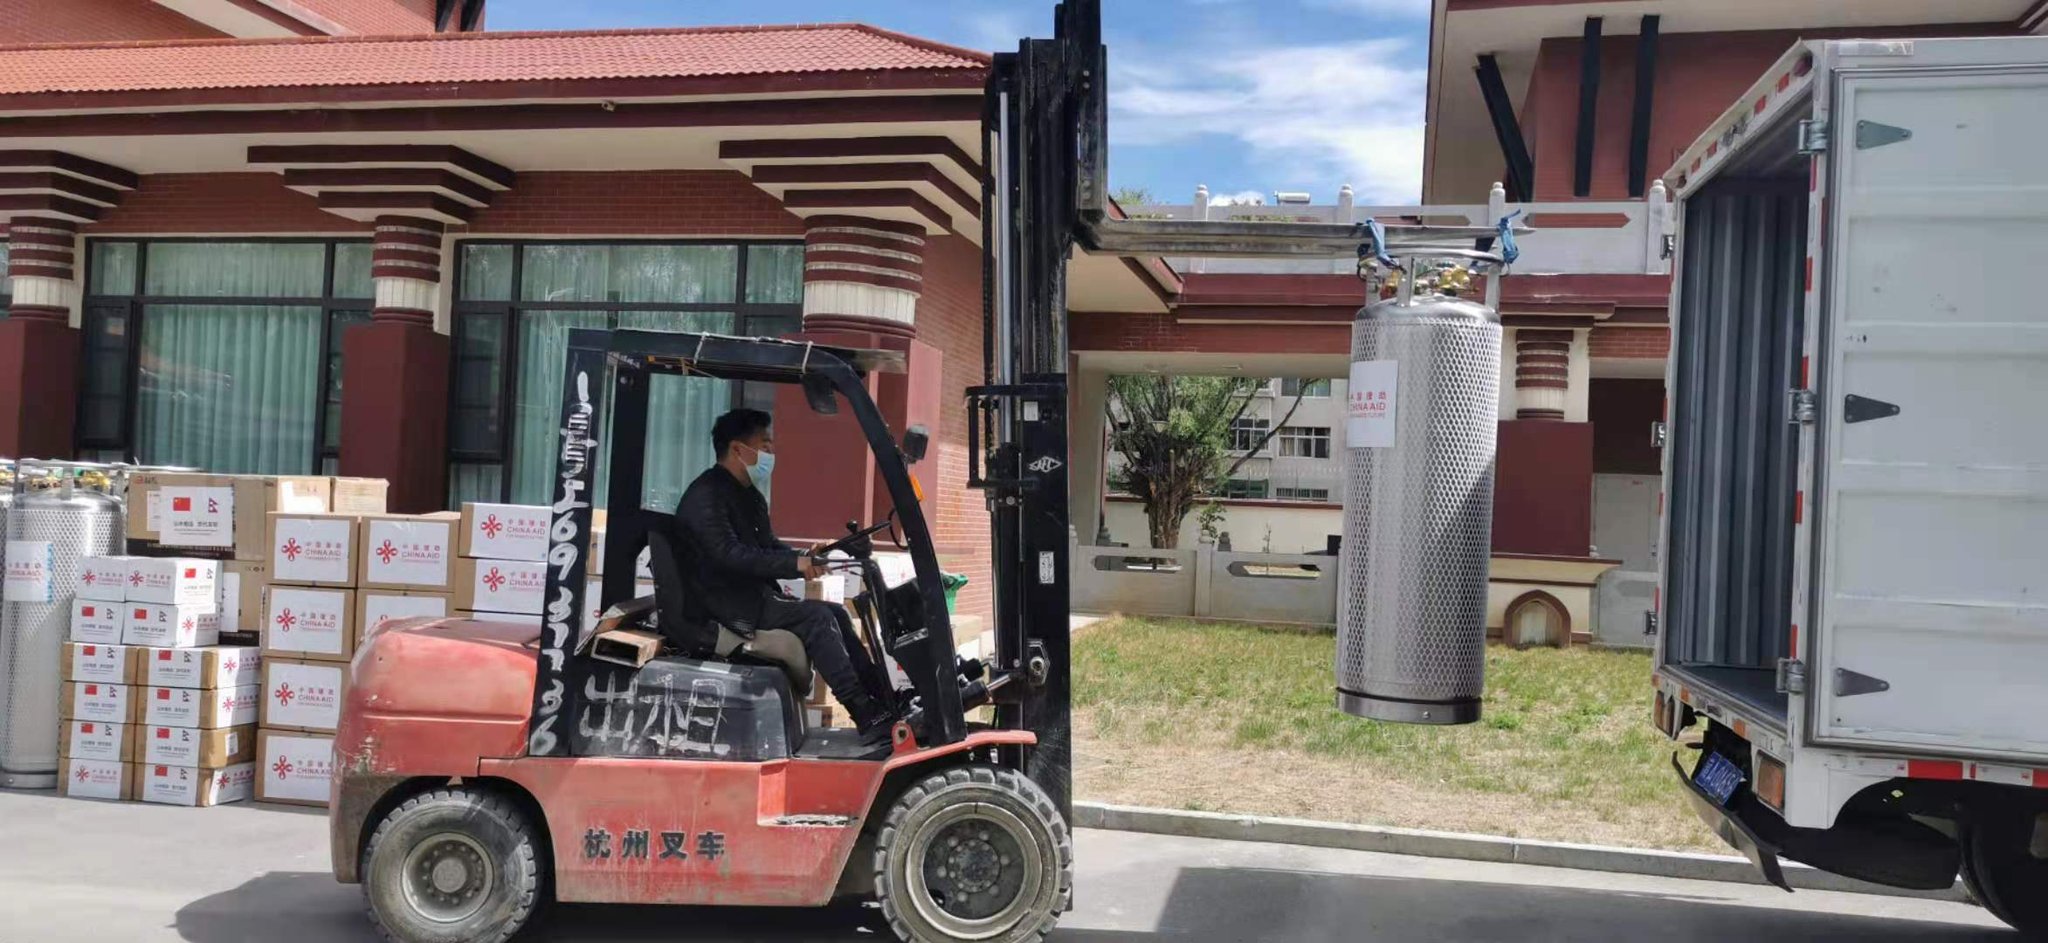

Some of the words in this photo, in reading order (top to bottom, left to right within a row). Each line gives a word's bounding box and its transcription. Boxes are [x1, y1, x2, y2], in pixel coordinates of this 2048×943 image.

[1369, 402, 1386, 411] AID
[507, 526, 531, 534] CHINA
[300, 619, 322, 627] CHINA
[579, 671, 731, 755] 出租
[584, 828, 724, 861] 杭州叉车
